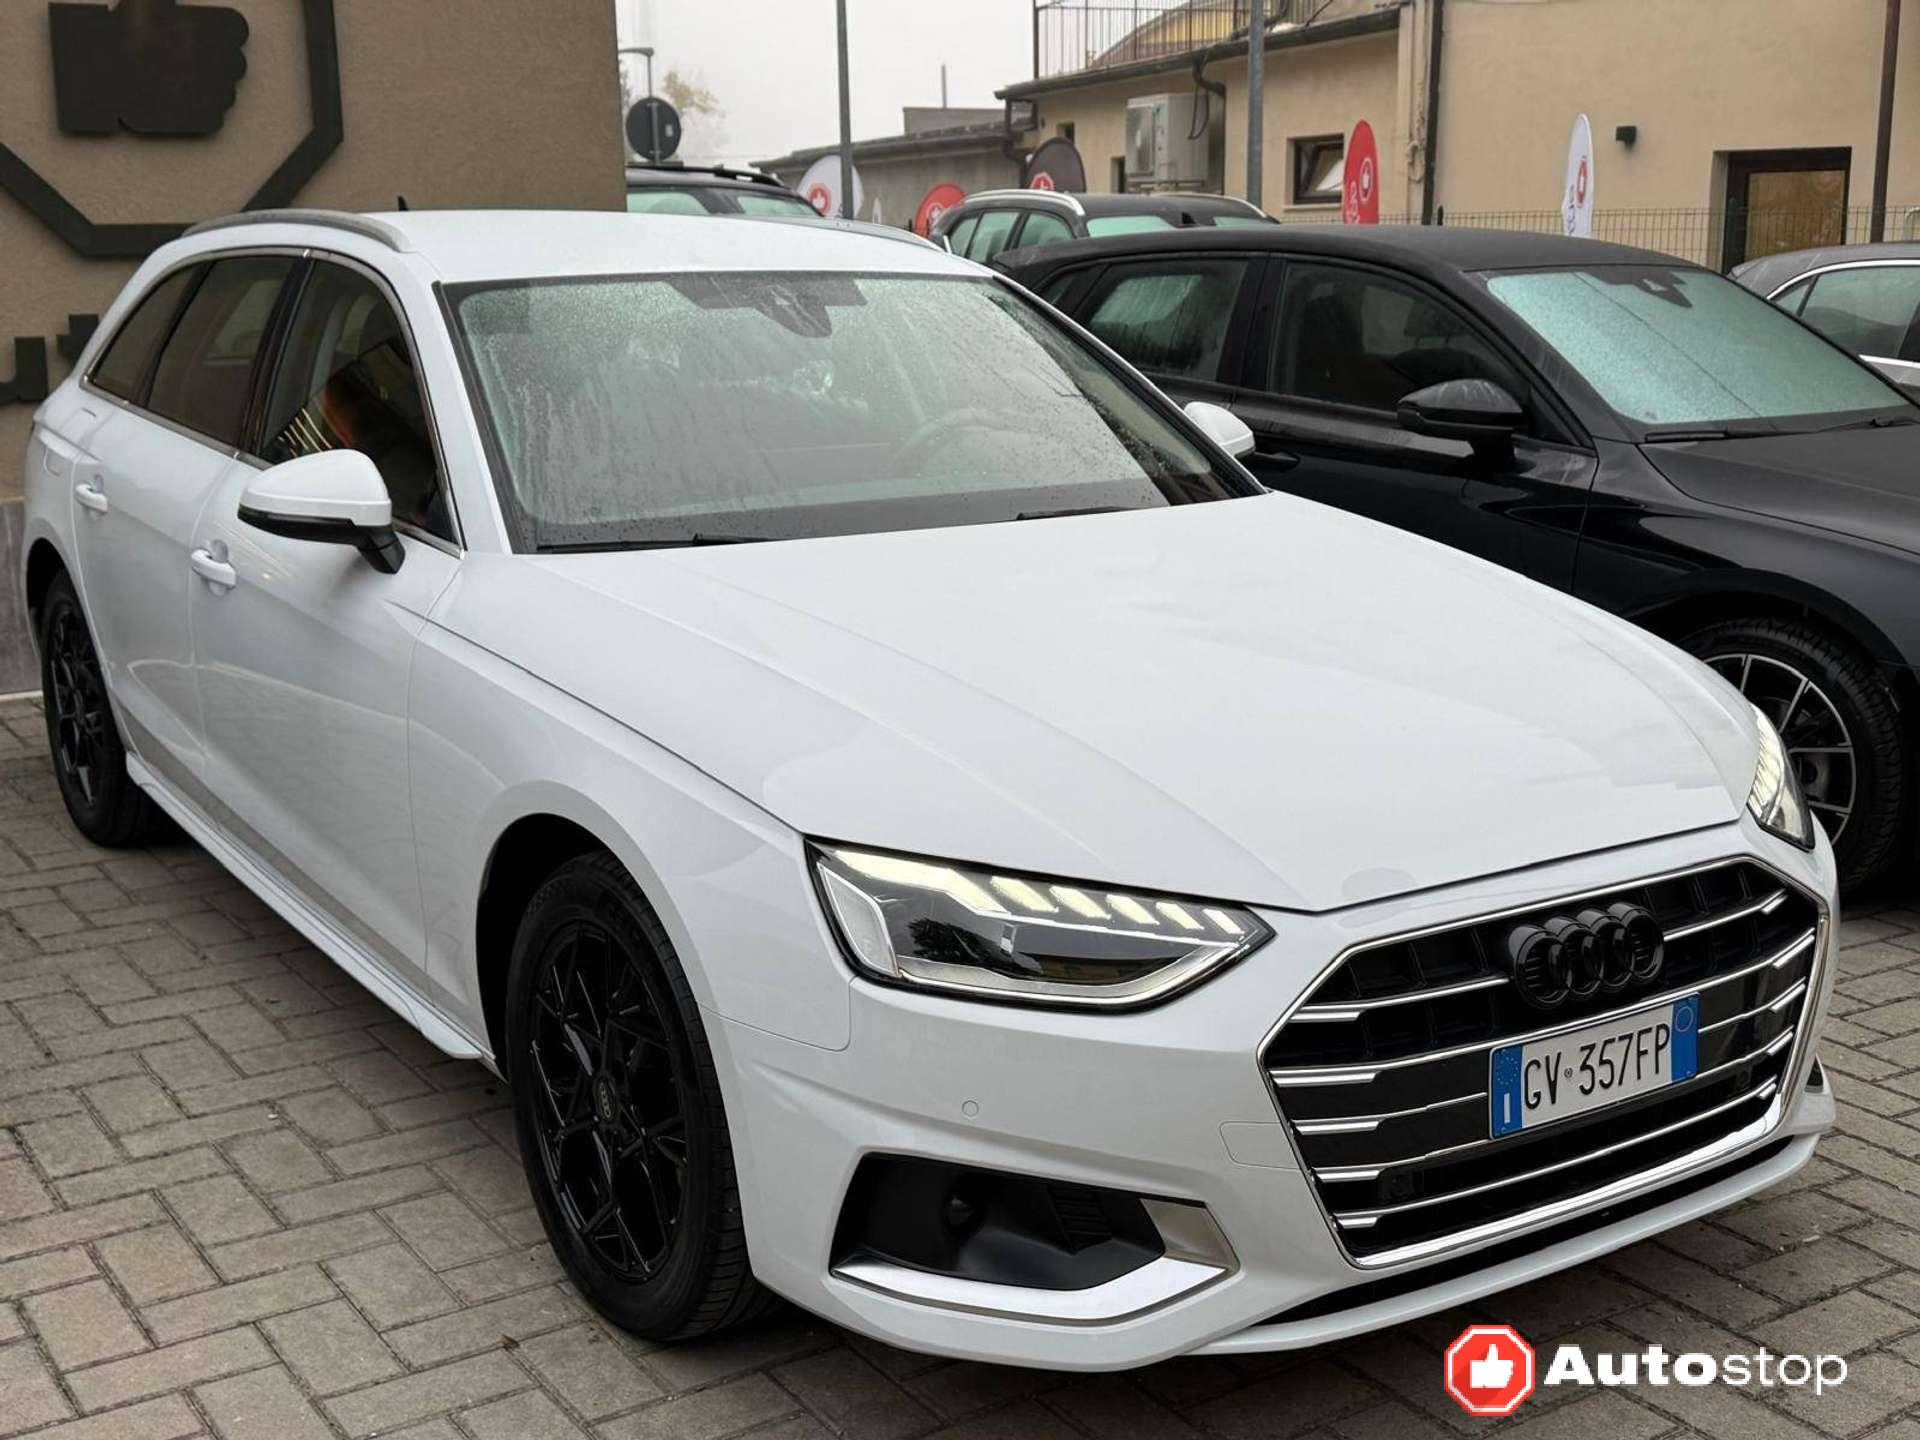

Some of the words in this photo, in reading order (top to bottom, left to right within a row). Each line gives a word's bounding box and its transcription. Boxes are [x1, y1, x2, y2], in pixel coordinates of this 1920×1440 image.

[1524, 1051, 1562, 1110] GV
[1579, 1023, 1671, 1096] 357FP
[1503, 1092, 1511, 1125] I
